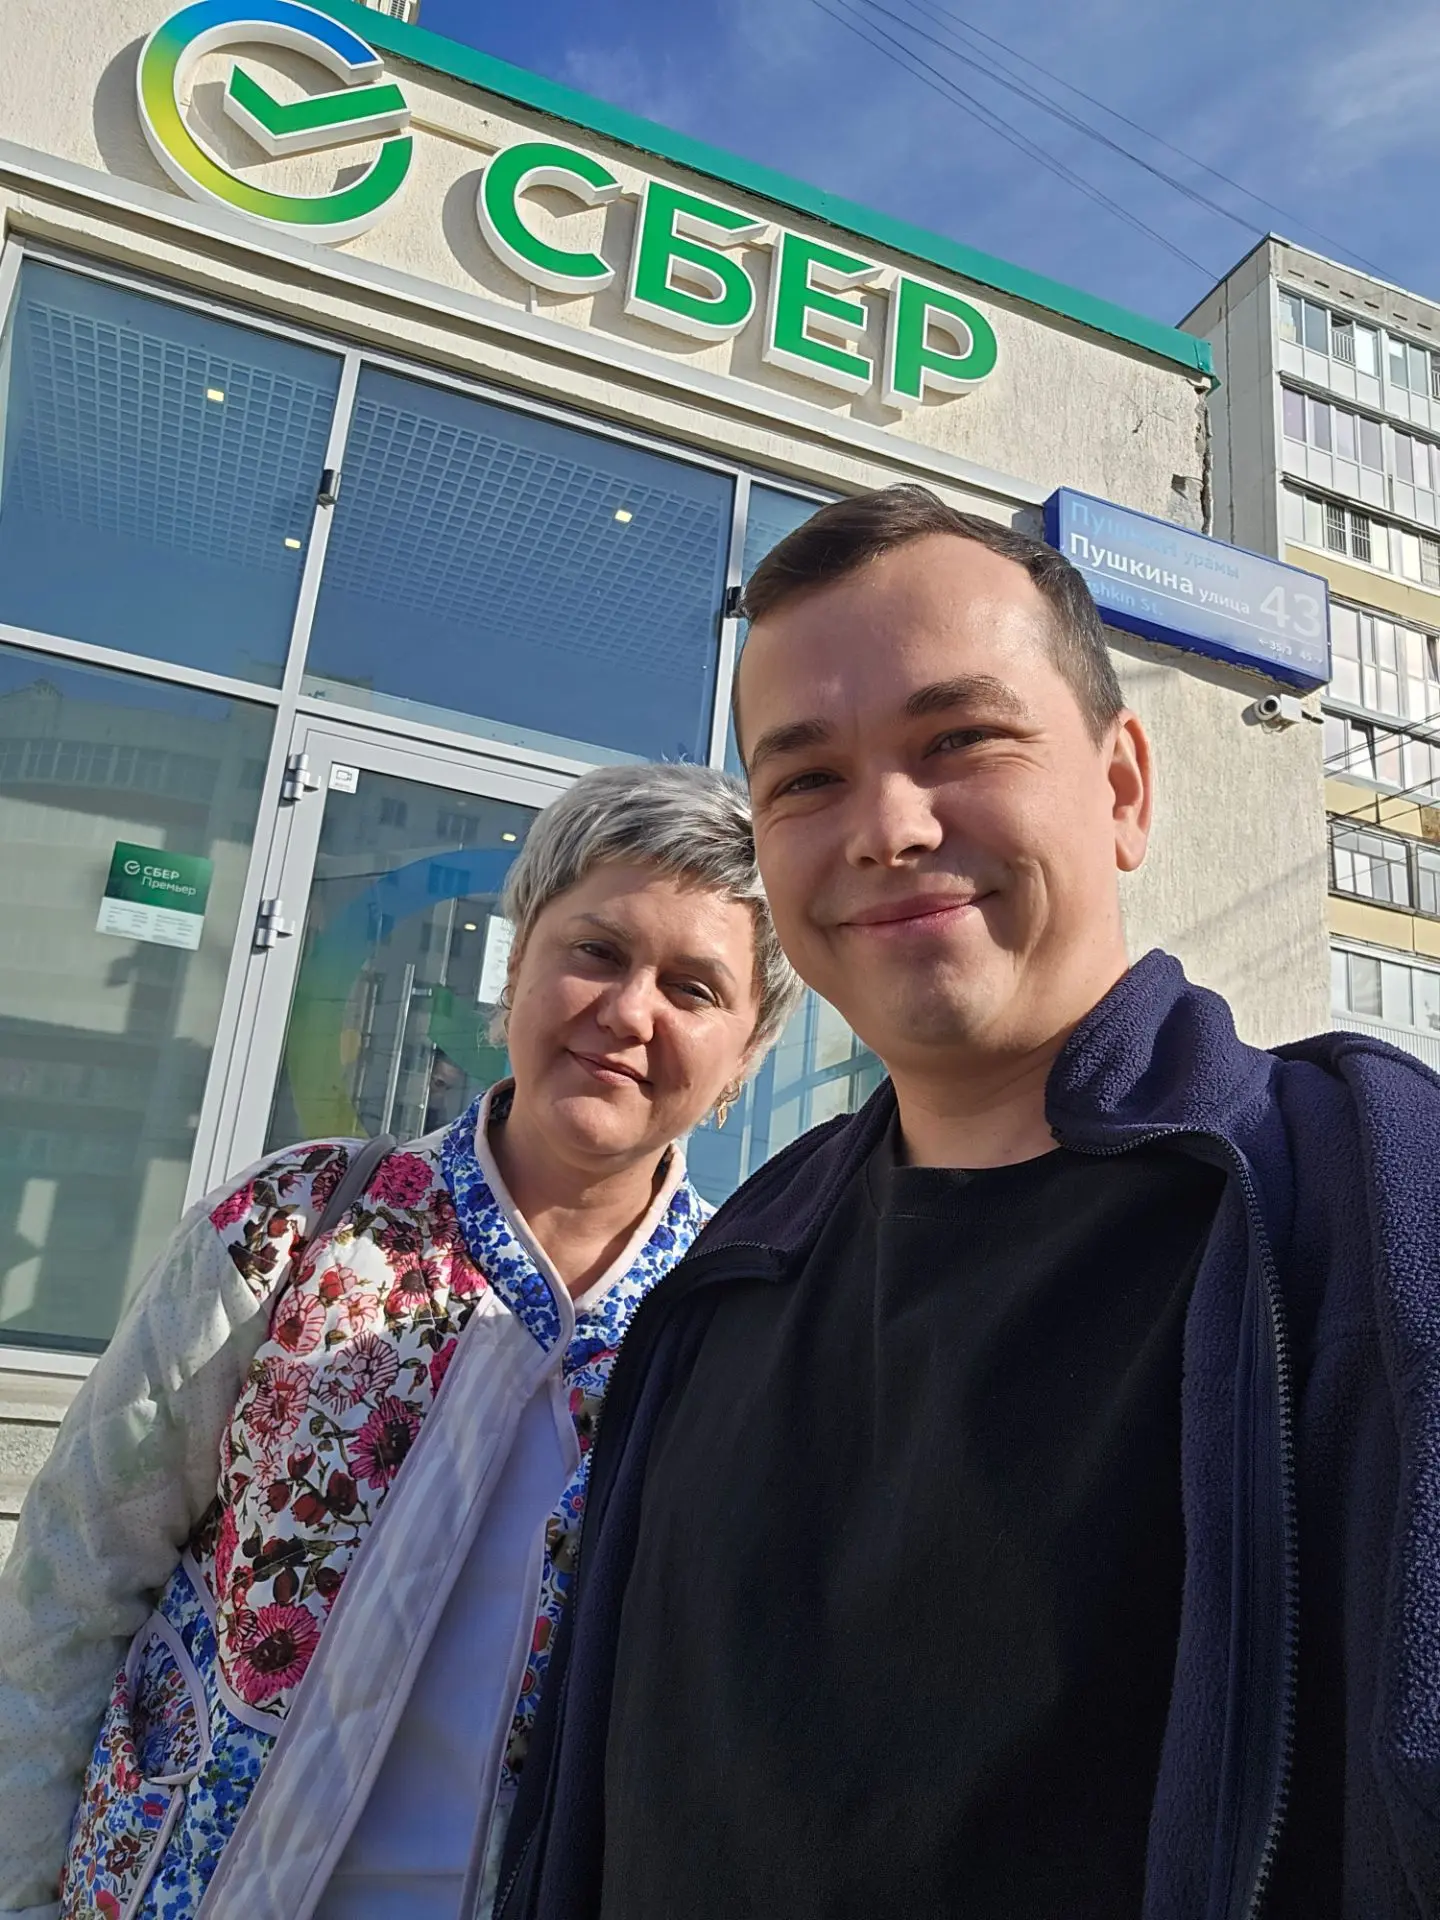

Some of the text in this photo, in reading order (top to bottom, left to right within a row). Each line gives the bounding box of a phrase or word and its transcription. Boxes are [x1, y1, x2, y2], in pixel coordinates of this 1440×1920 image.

[478, 141, 998, 409] СБЕР
[1069, 532, 1251, 615] Пушкина улица
[1259, 585, 1322, 638] 43
[141, 875, 197, 897] Премьер
[143, 865, 180, 881] СБЕР
